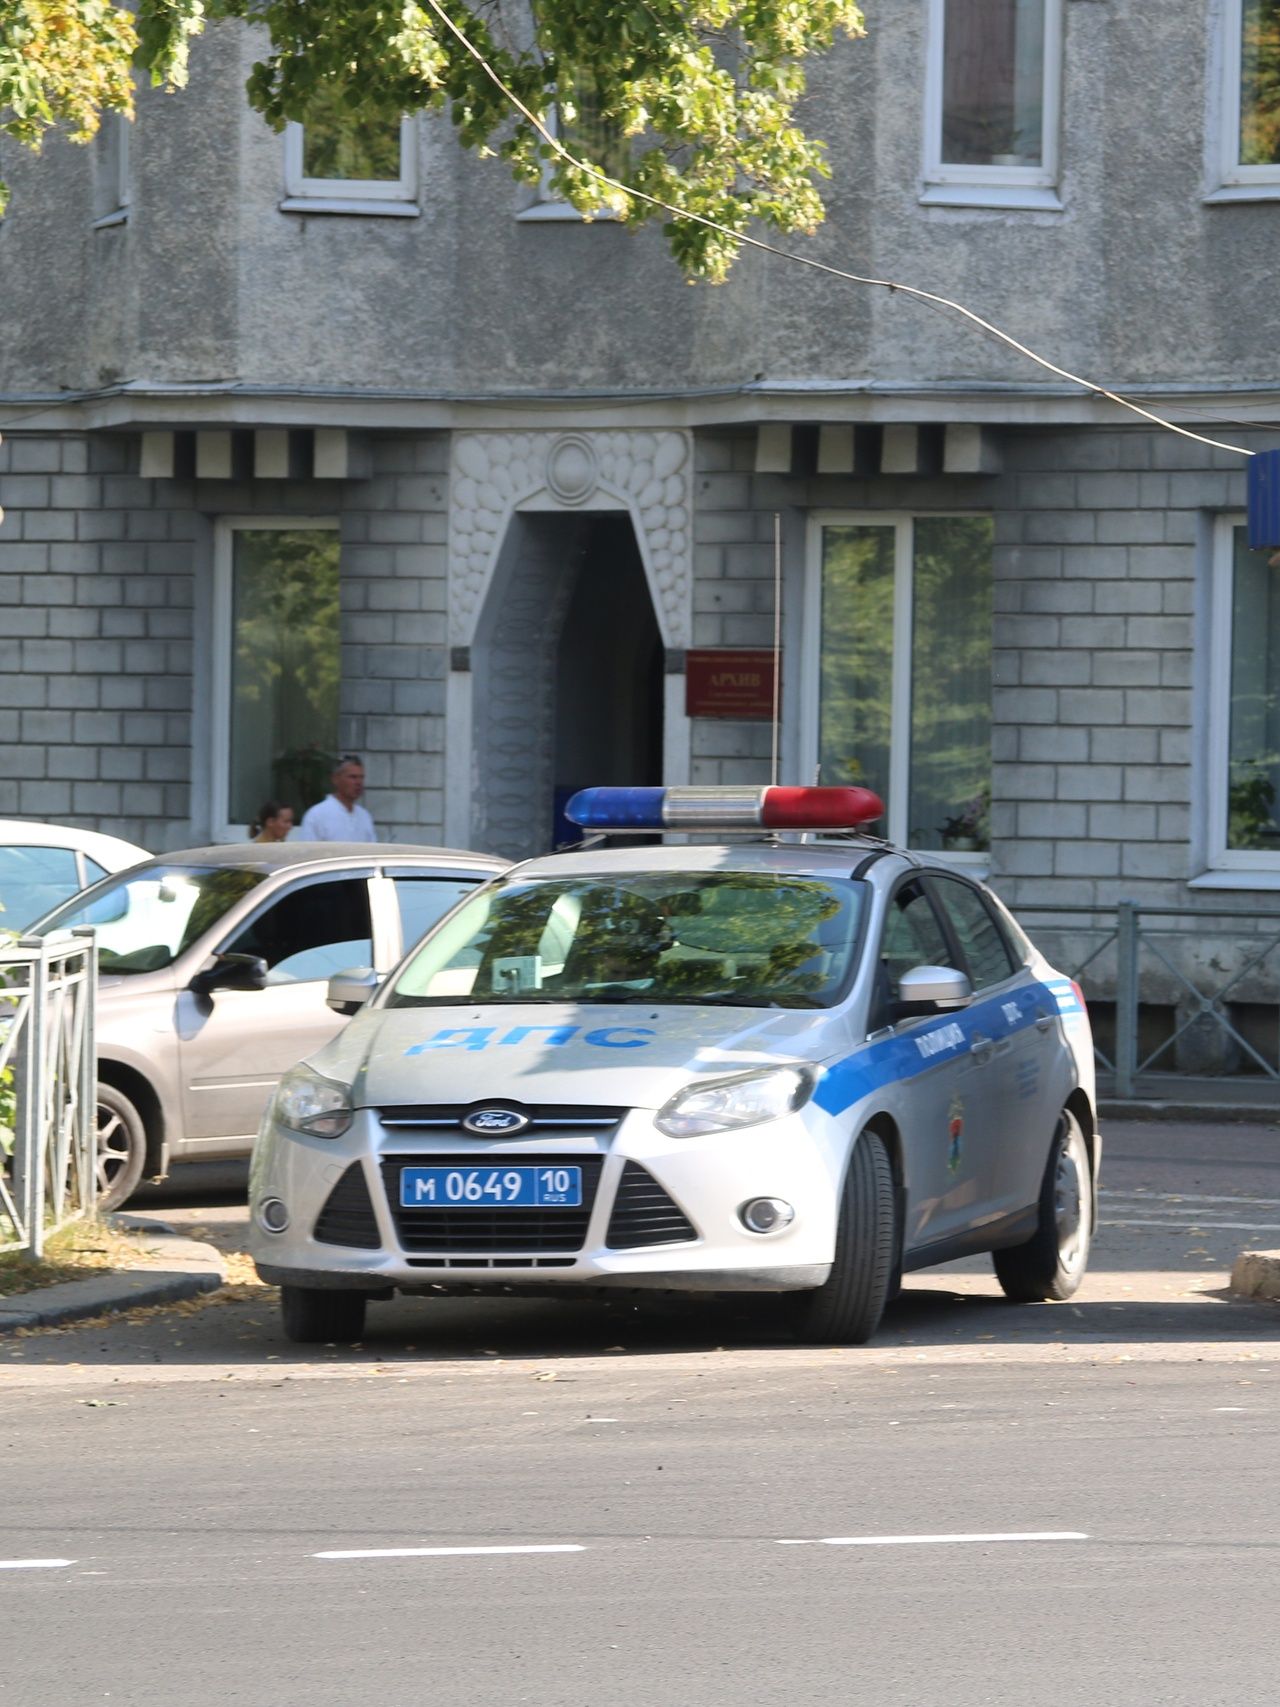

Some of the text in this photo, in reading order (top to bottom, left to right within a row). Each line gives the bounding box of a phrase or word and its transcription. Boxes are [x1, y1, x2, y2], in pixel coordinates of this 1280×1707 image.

[404, 1025, 657, 1056] ДПС
[475, 1113, 512, 1127] Ford
[445, 1171, 523, 1201] 0649
[540, 1170, 570, 1193] 10
[543, 1194, 567, 1202] RUS
